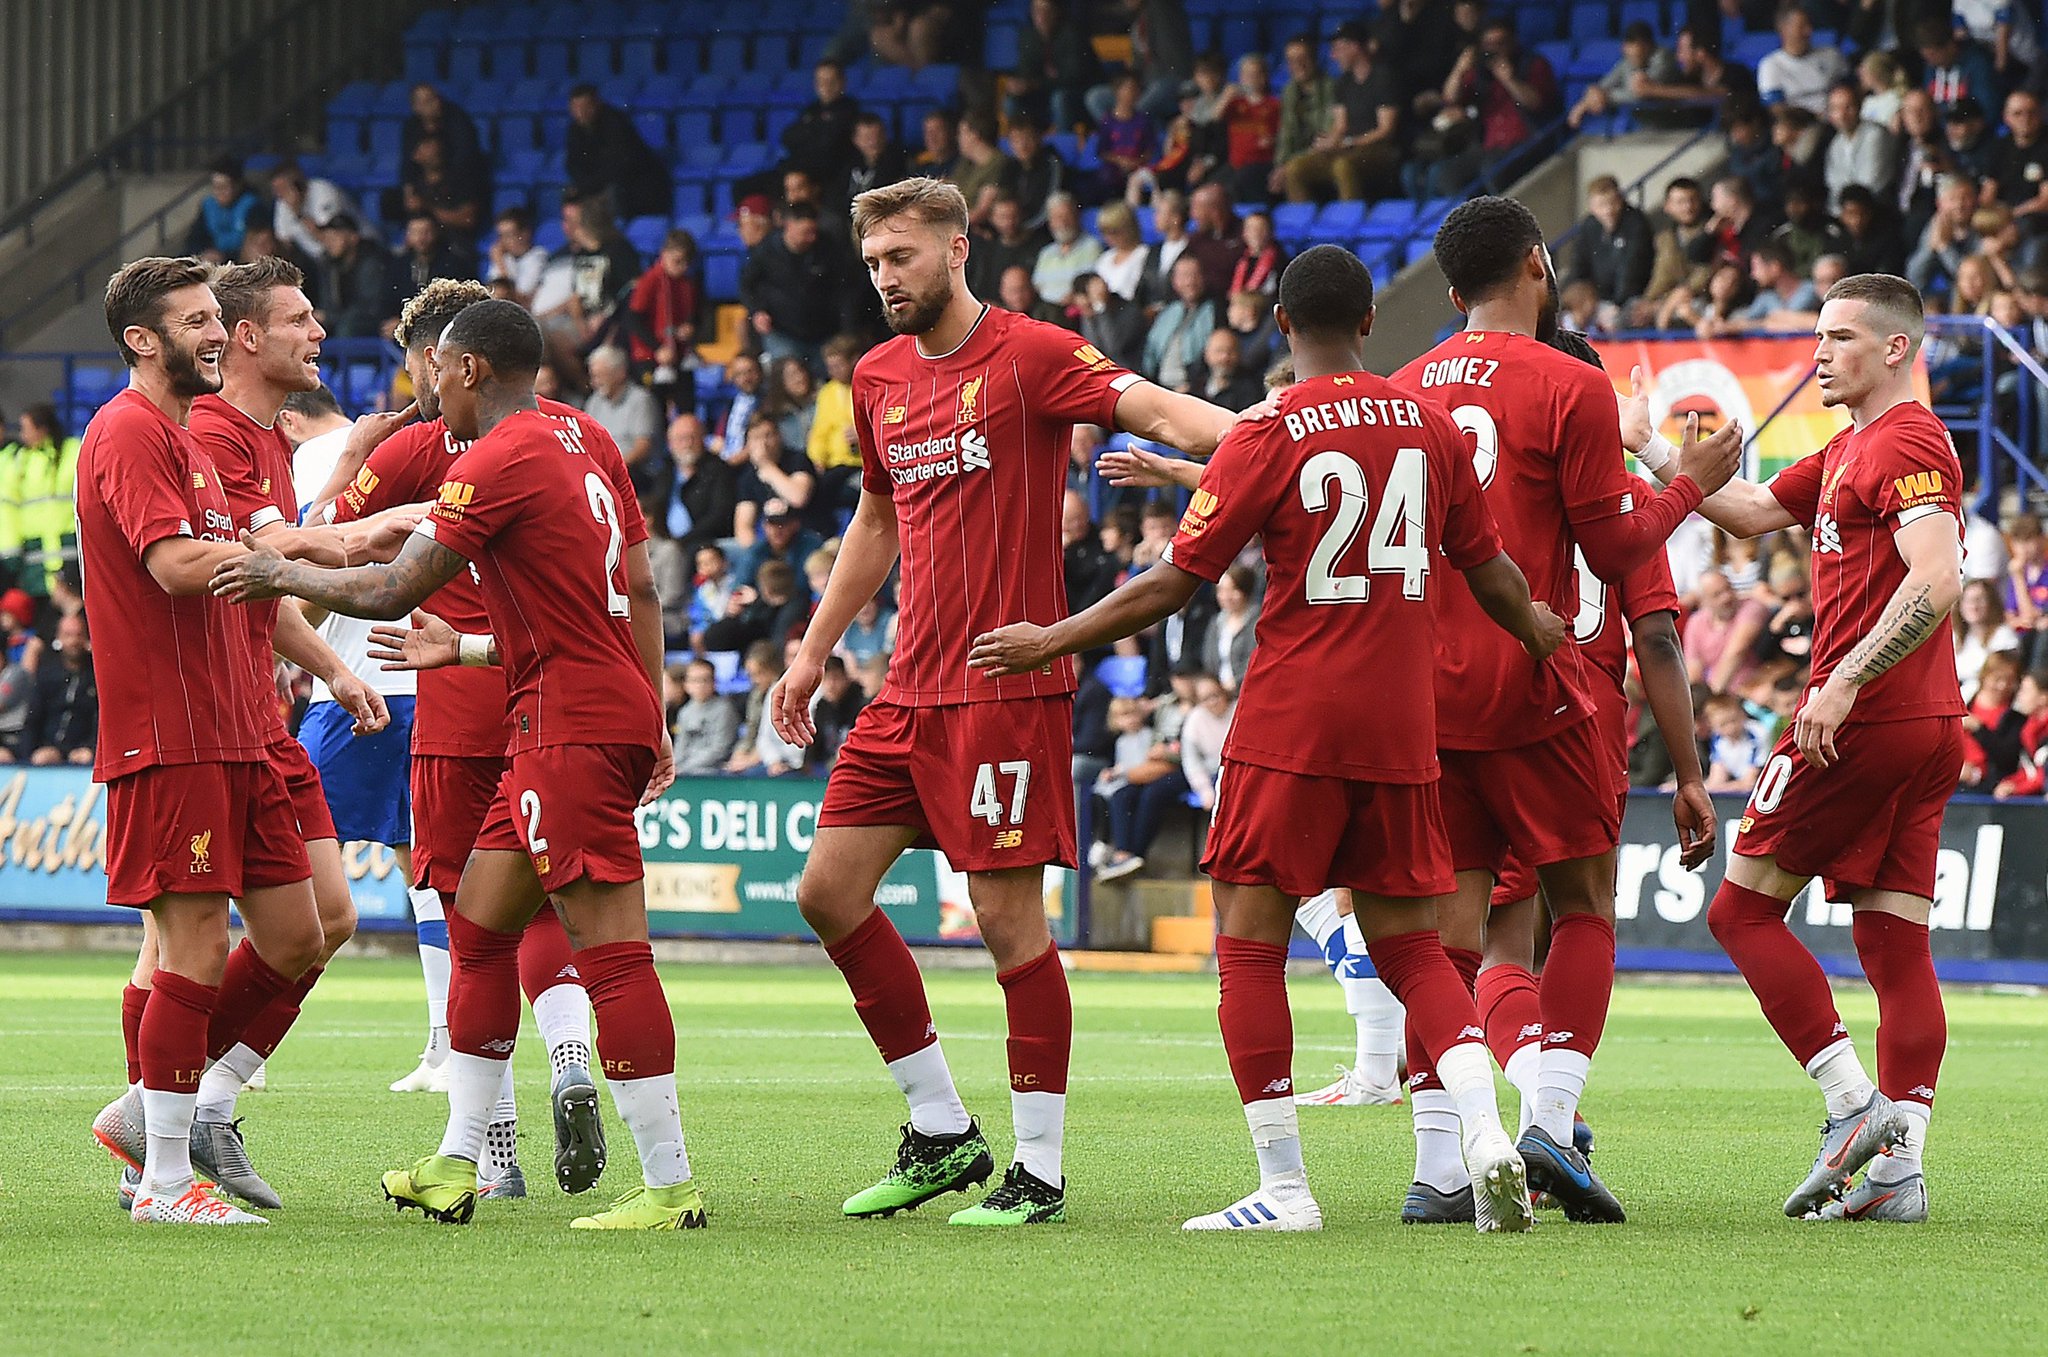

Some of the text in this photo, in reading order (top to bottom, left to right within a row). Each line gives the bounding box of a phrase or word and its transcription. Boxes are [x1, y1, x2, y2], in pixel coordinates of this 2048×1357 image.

[1421, 357, 1500, 388] GOMEZ
[1284, 396, 1424, 442] BREWSTER
[887, 431, 957, 463] Standard
[890, 455, 959, 485] Chartered
[1894, 470, 1943, 500] WU
[1899, 494, 1948, 510] Western
[584, 471, 632, 623] 2
[1299, 448, 1430, 605] 24
[971, 761, 1031, 827] 47
[520, 789, 549, 854] 2
[701, 799, 778, 851] DELI
